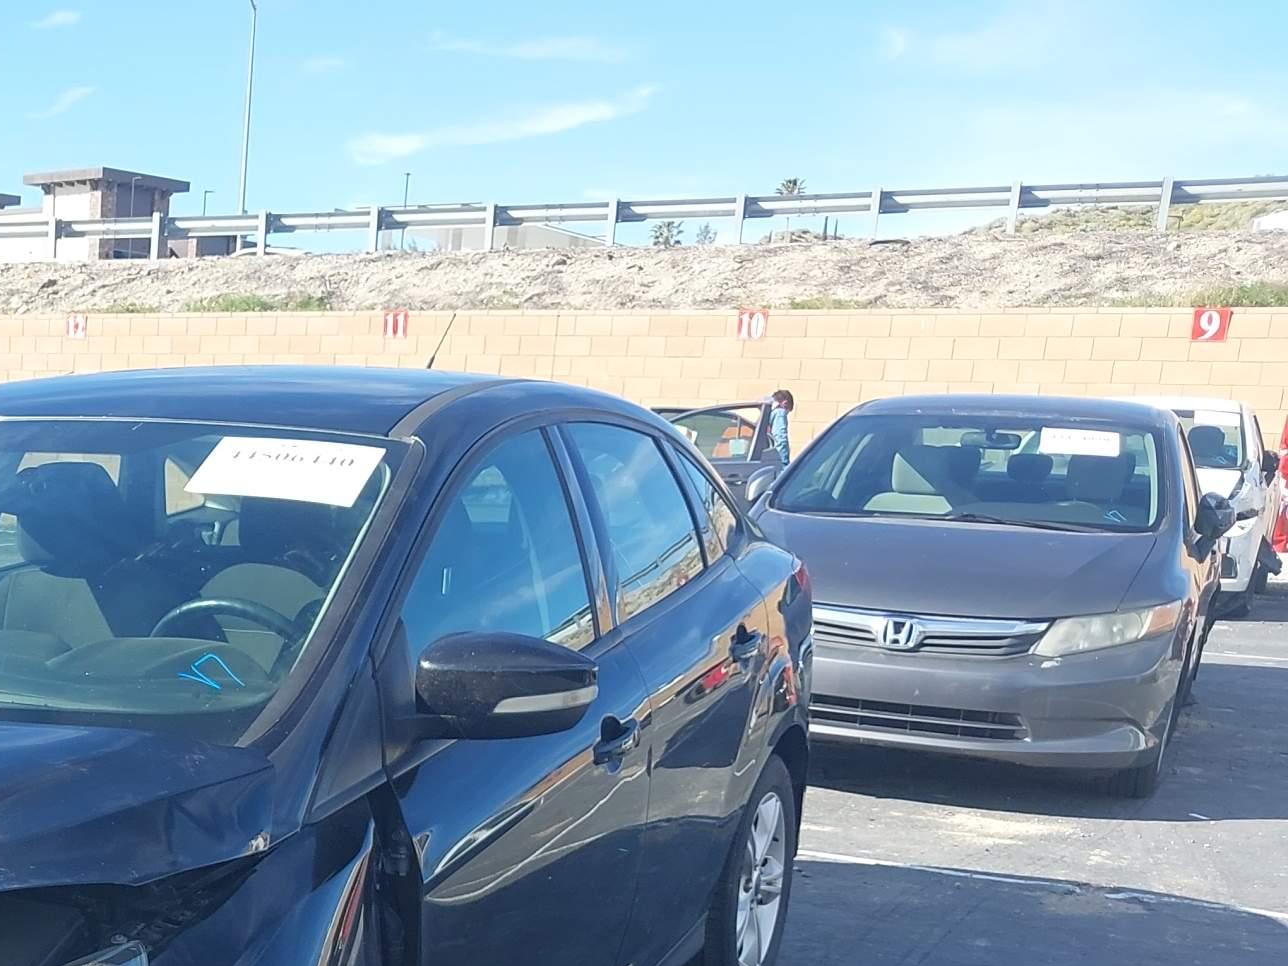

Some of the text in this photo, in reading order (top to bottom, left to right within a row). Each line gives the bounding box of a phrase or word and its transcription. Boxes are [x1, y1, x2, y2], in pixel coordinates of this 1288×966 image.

[385, 312, 405, 337] 11
[740, 311, 765, 340] 10
[1197, 309, 1221, 340] 9
